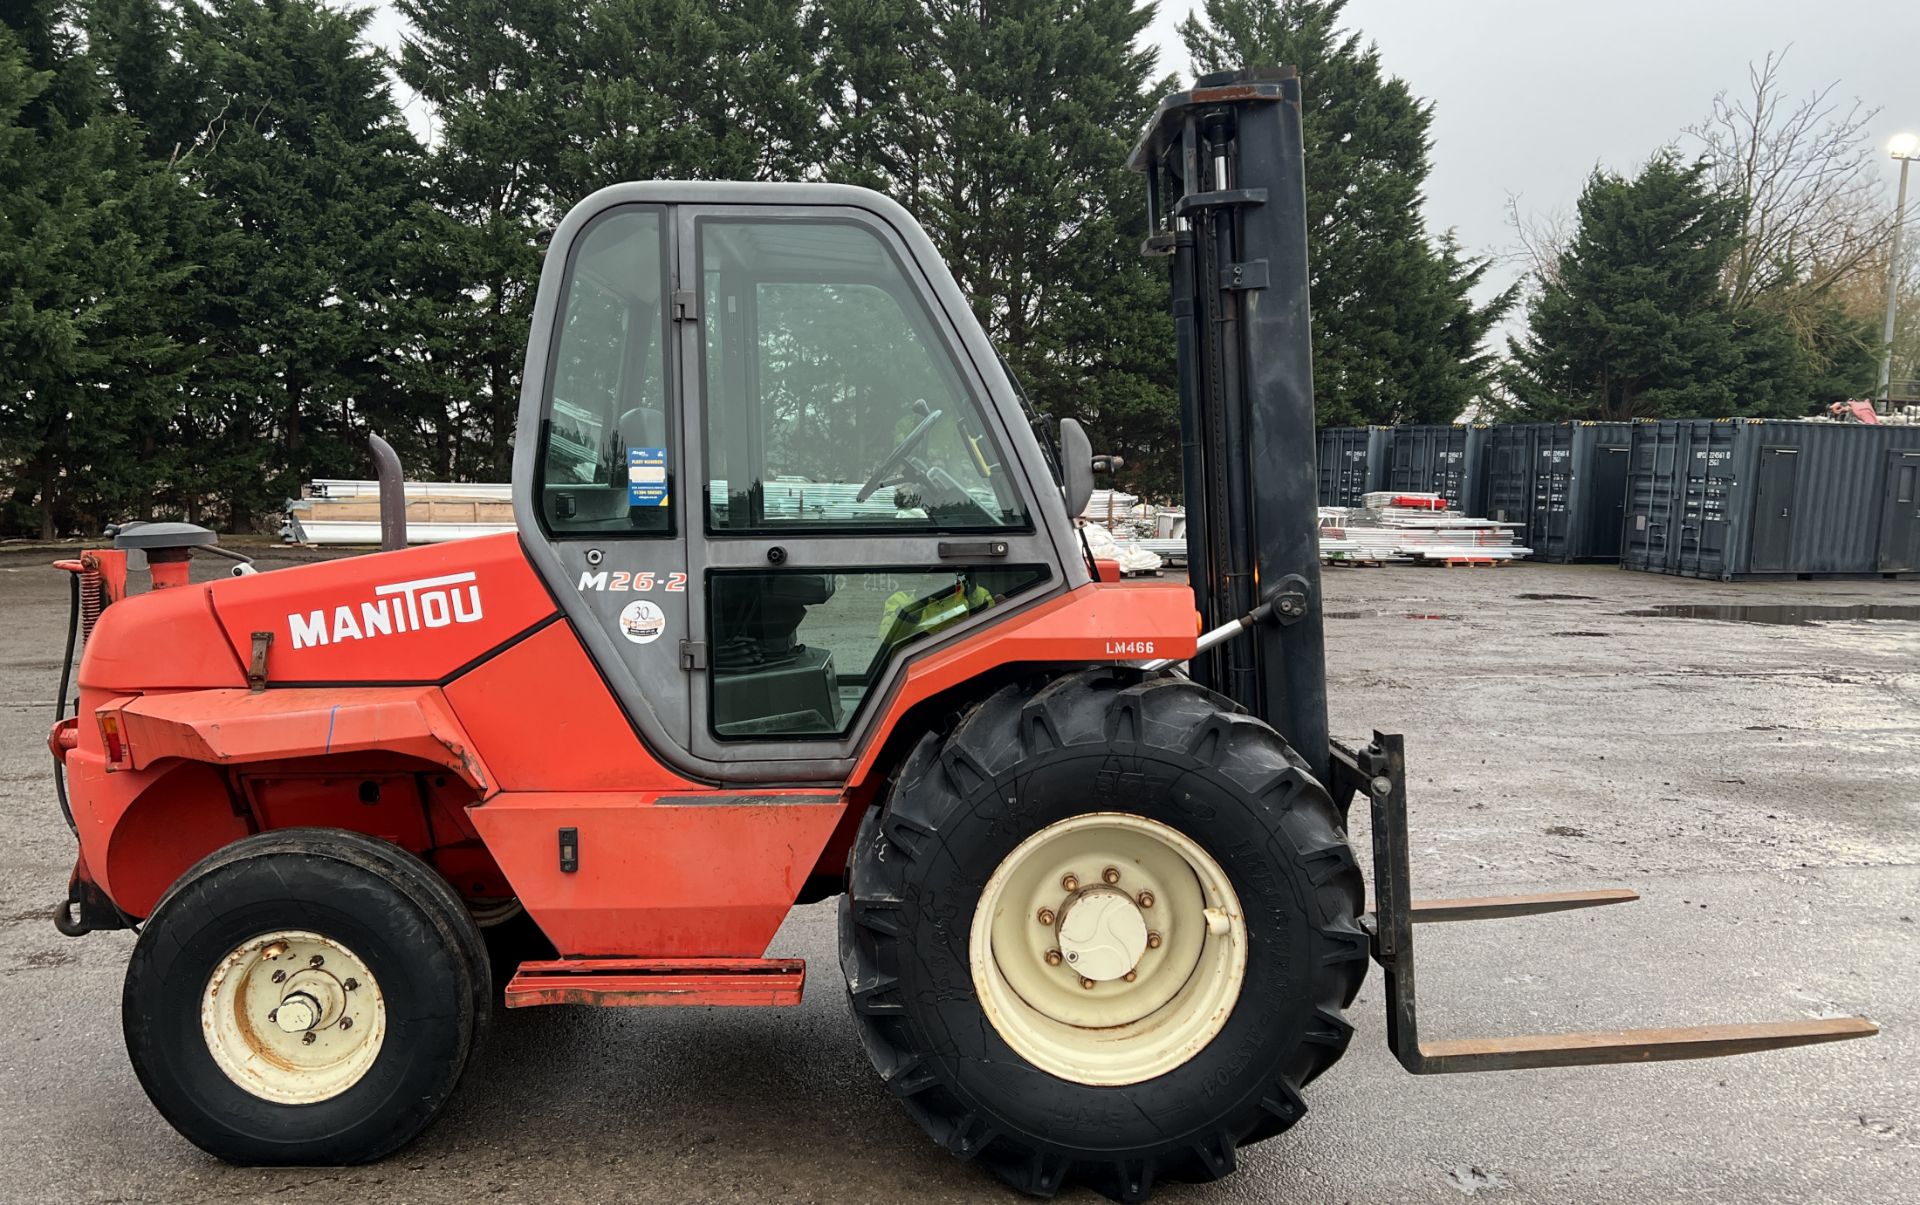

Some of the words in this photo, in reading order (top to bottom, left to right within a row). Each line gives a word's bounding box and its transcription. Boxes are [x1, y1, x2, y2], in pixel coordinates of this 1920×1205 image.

[578, 572, 687, 592] M26-2
[288, 571, 483, 649] MANITOU
[635, 606, 649, 620] 30
[1105, 641, 1154, 654] LM466
